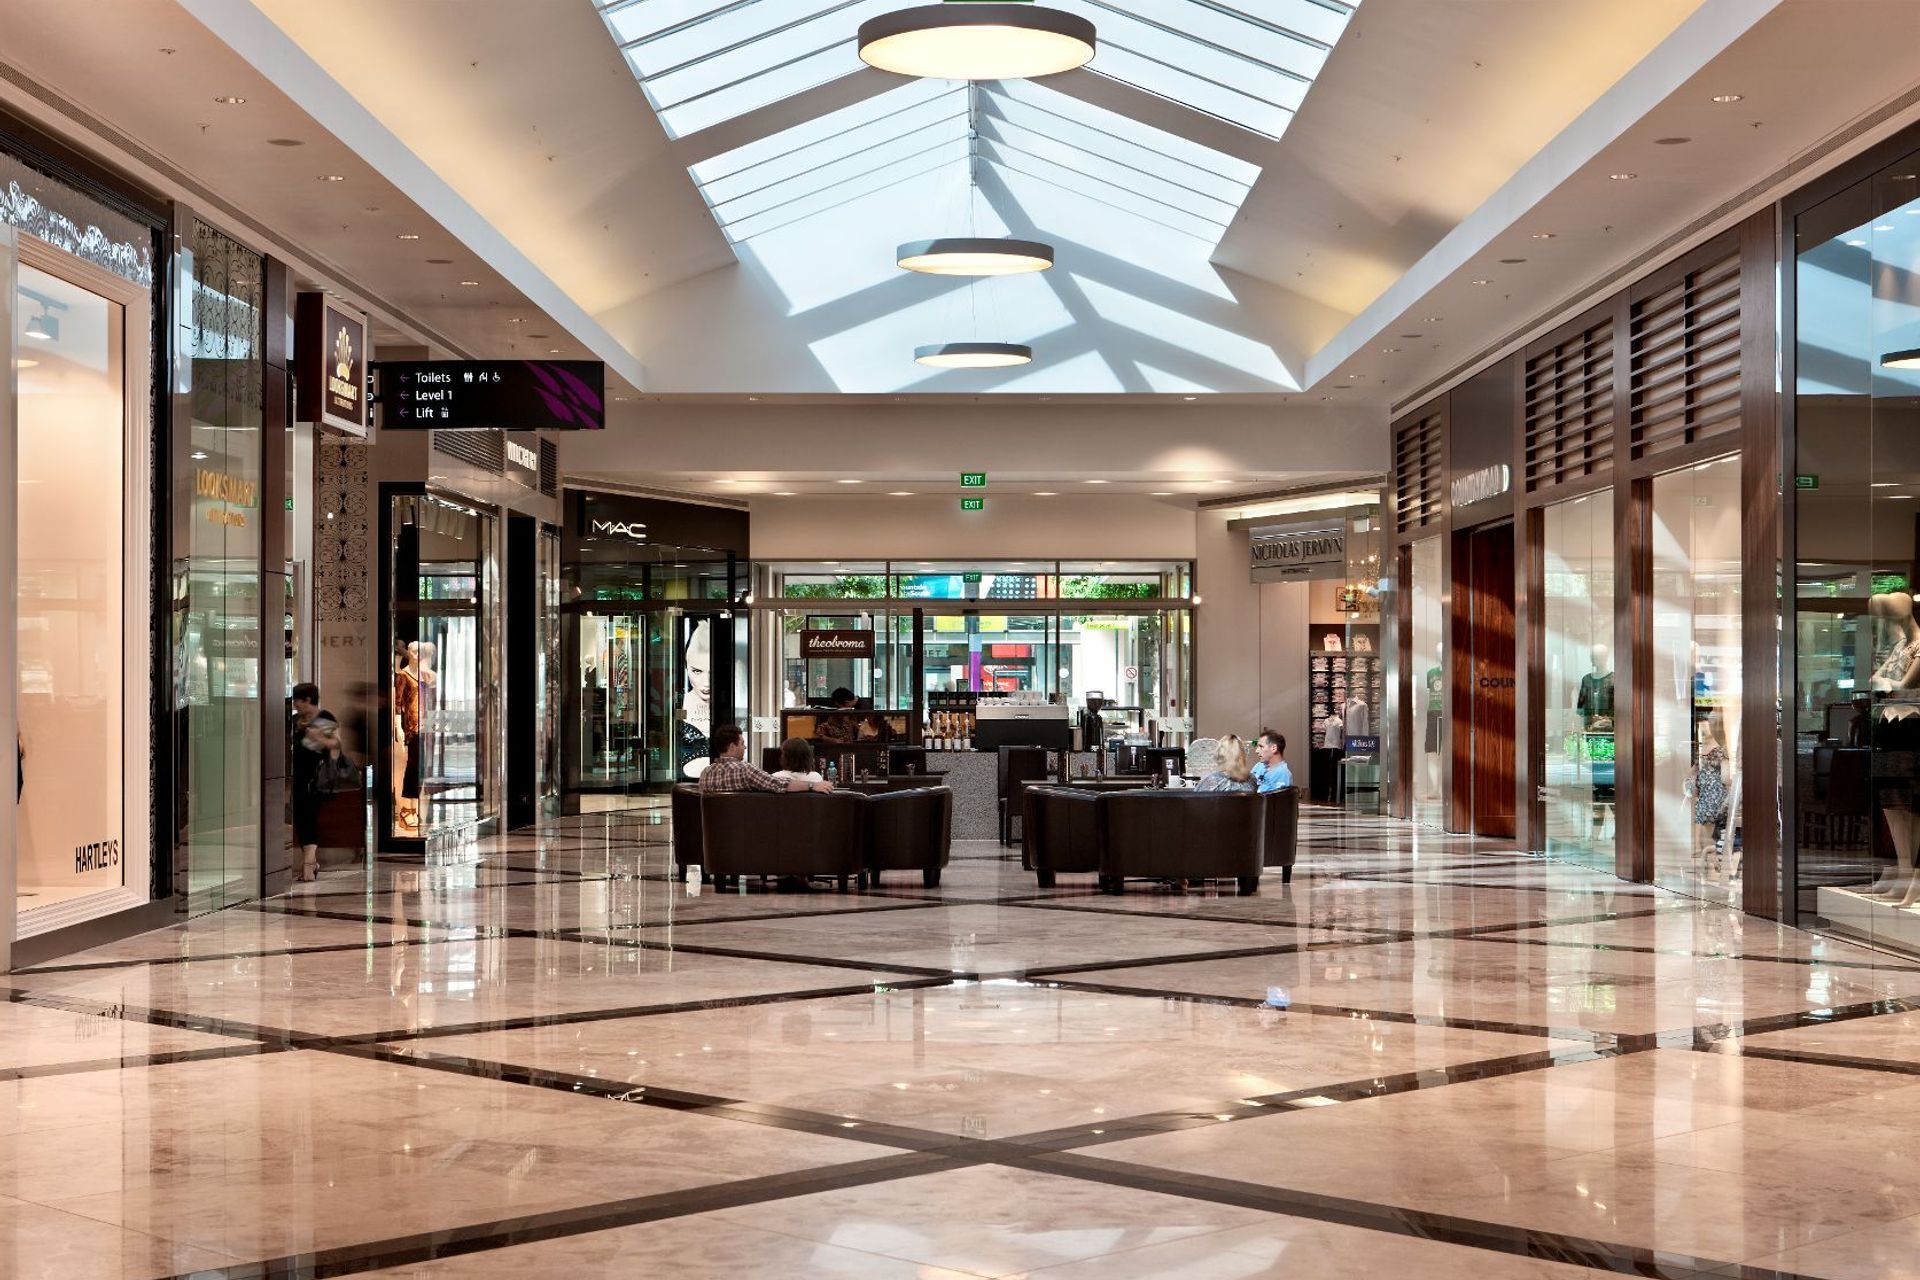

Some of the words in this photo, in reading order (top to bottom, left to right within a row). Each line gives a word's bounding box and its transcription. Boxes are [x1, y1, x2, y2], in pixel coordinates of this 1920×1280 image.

[415, 371, 452, 384] Toilets
[415, 389, 444, 401] Level
[447, 390, 453, 400] 1
[416, 406, 434, 419] Lift
[963, 475, 983, 485] EXIT
[963, 500, 981, 509] EXIT
[1251, 540, 1301, 561] NICHOLAS
[1301, 536, 1345, 561] JERMYN
[808, 634, 866, 649] theobroma
[75, 839, 119, 874] HARTLEYS
